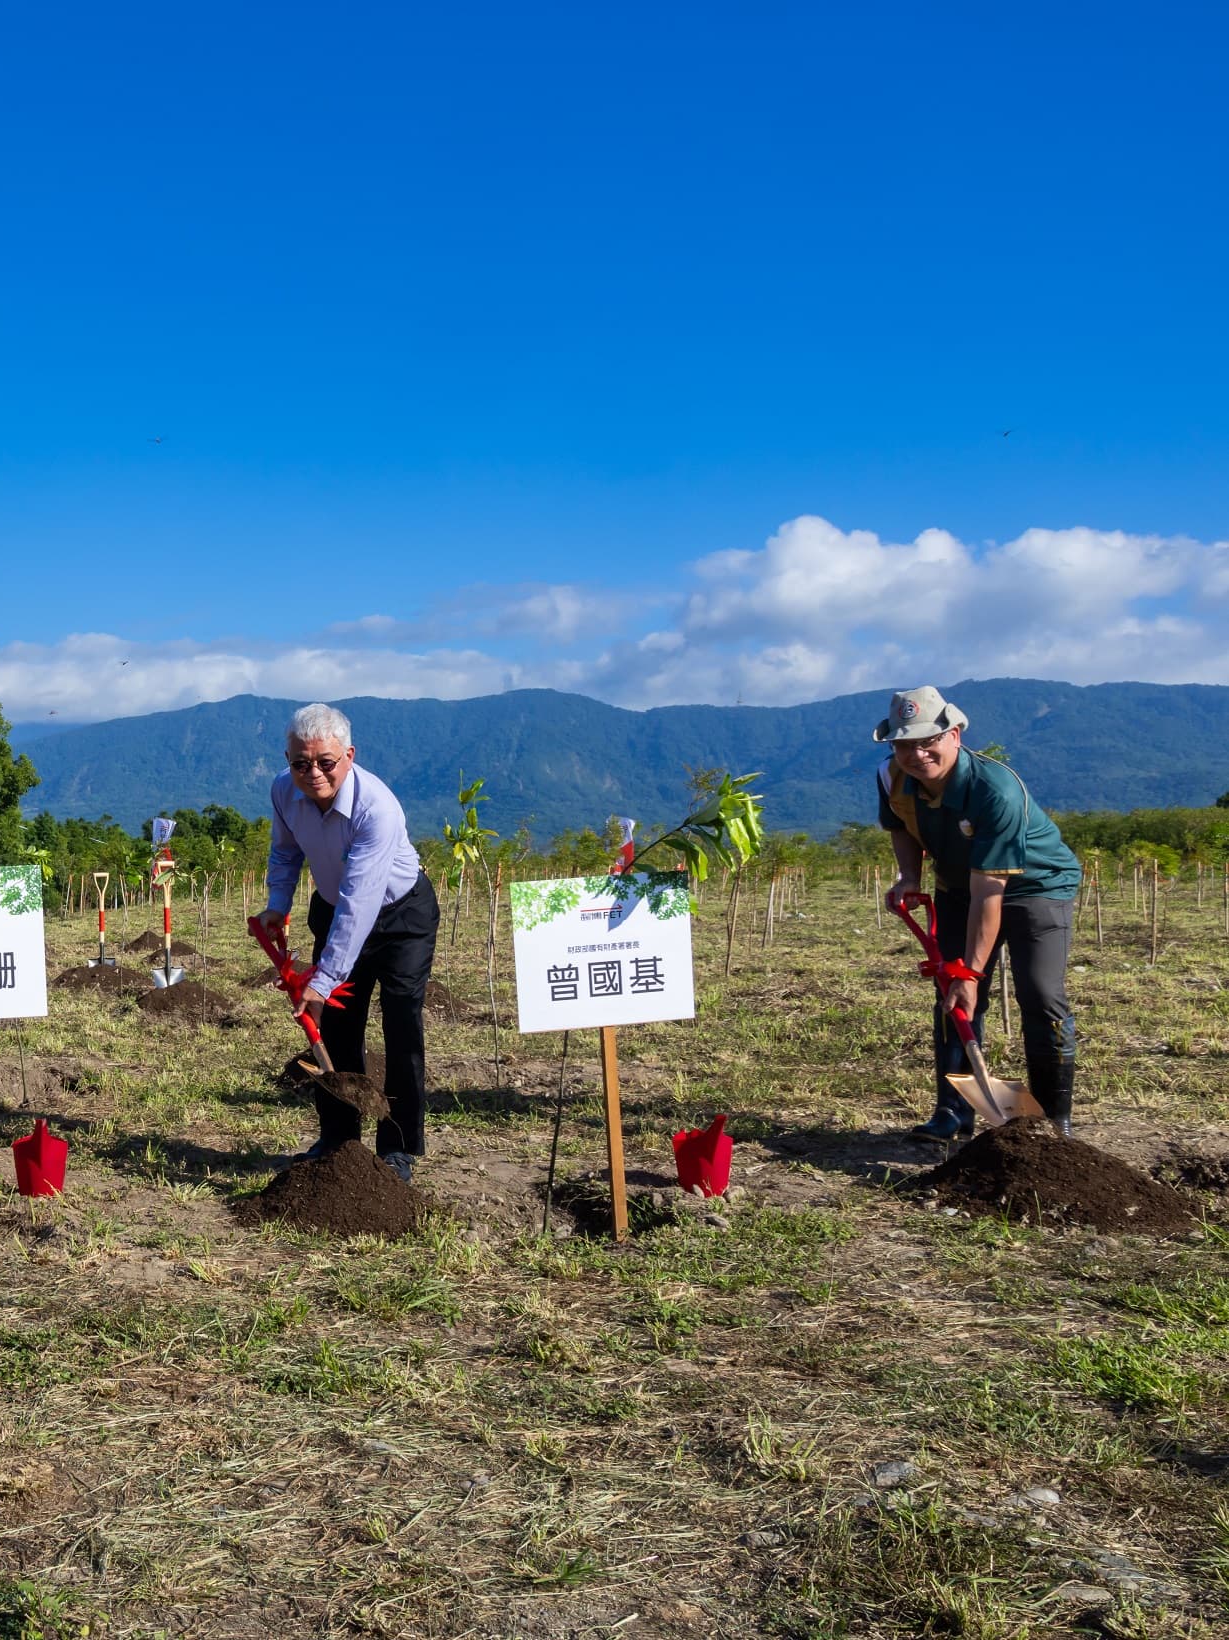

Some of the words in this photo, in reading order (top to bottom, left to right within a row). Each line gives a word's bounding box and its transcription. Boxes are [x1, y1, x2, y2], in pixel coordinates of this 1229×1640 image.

[603, 910, 623, 919] FET
[547, 956, 665, 1002] 曾國基
